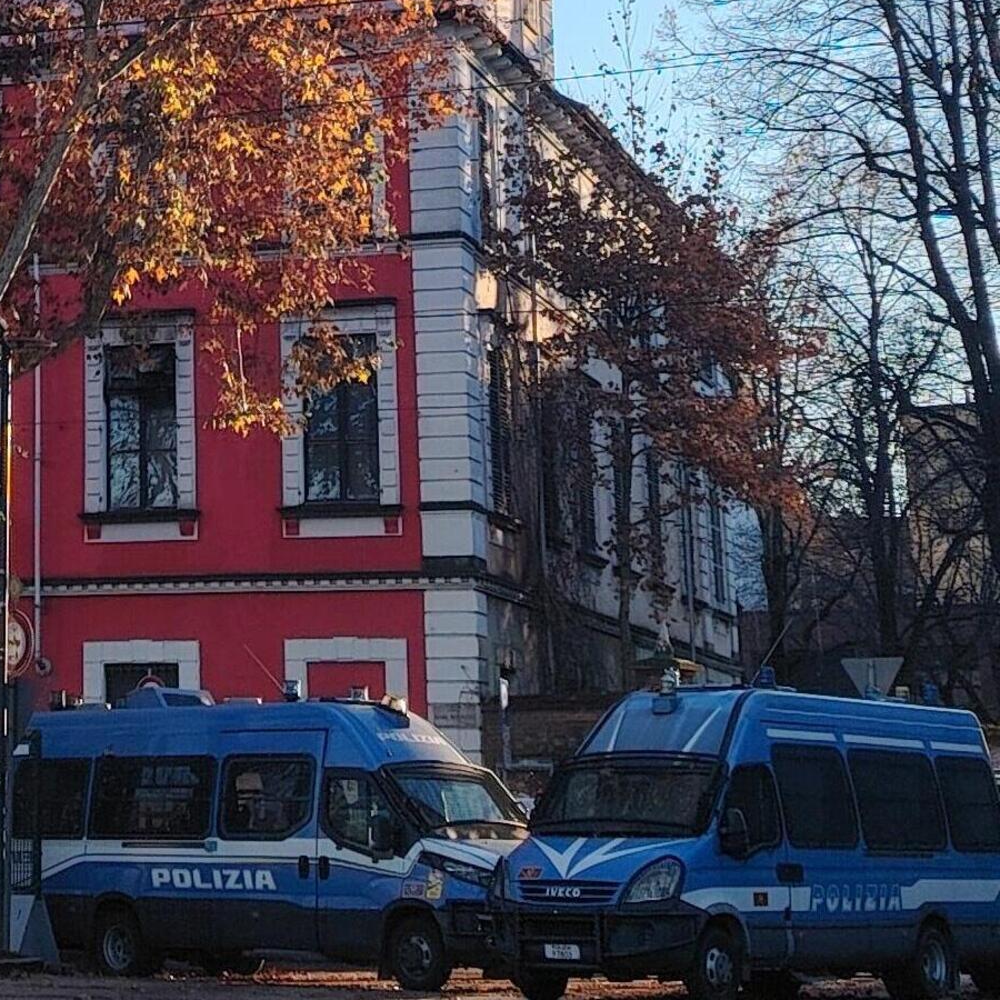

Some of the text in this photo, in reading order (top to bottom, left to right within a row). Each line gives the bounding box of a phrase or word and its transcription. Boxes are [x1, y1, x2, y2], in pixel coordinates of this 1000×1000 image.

[152, 868, 277, 890] POLIZIA
[545, 886, 581, 898] IVECO
[810, 883, 902, 912] POLIZIA
